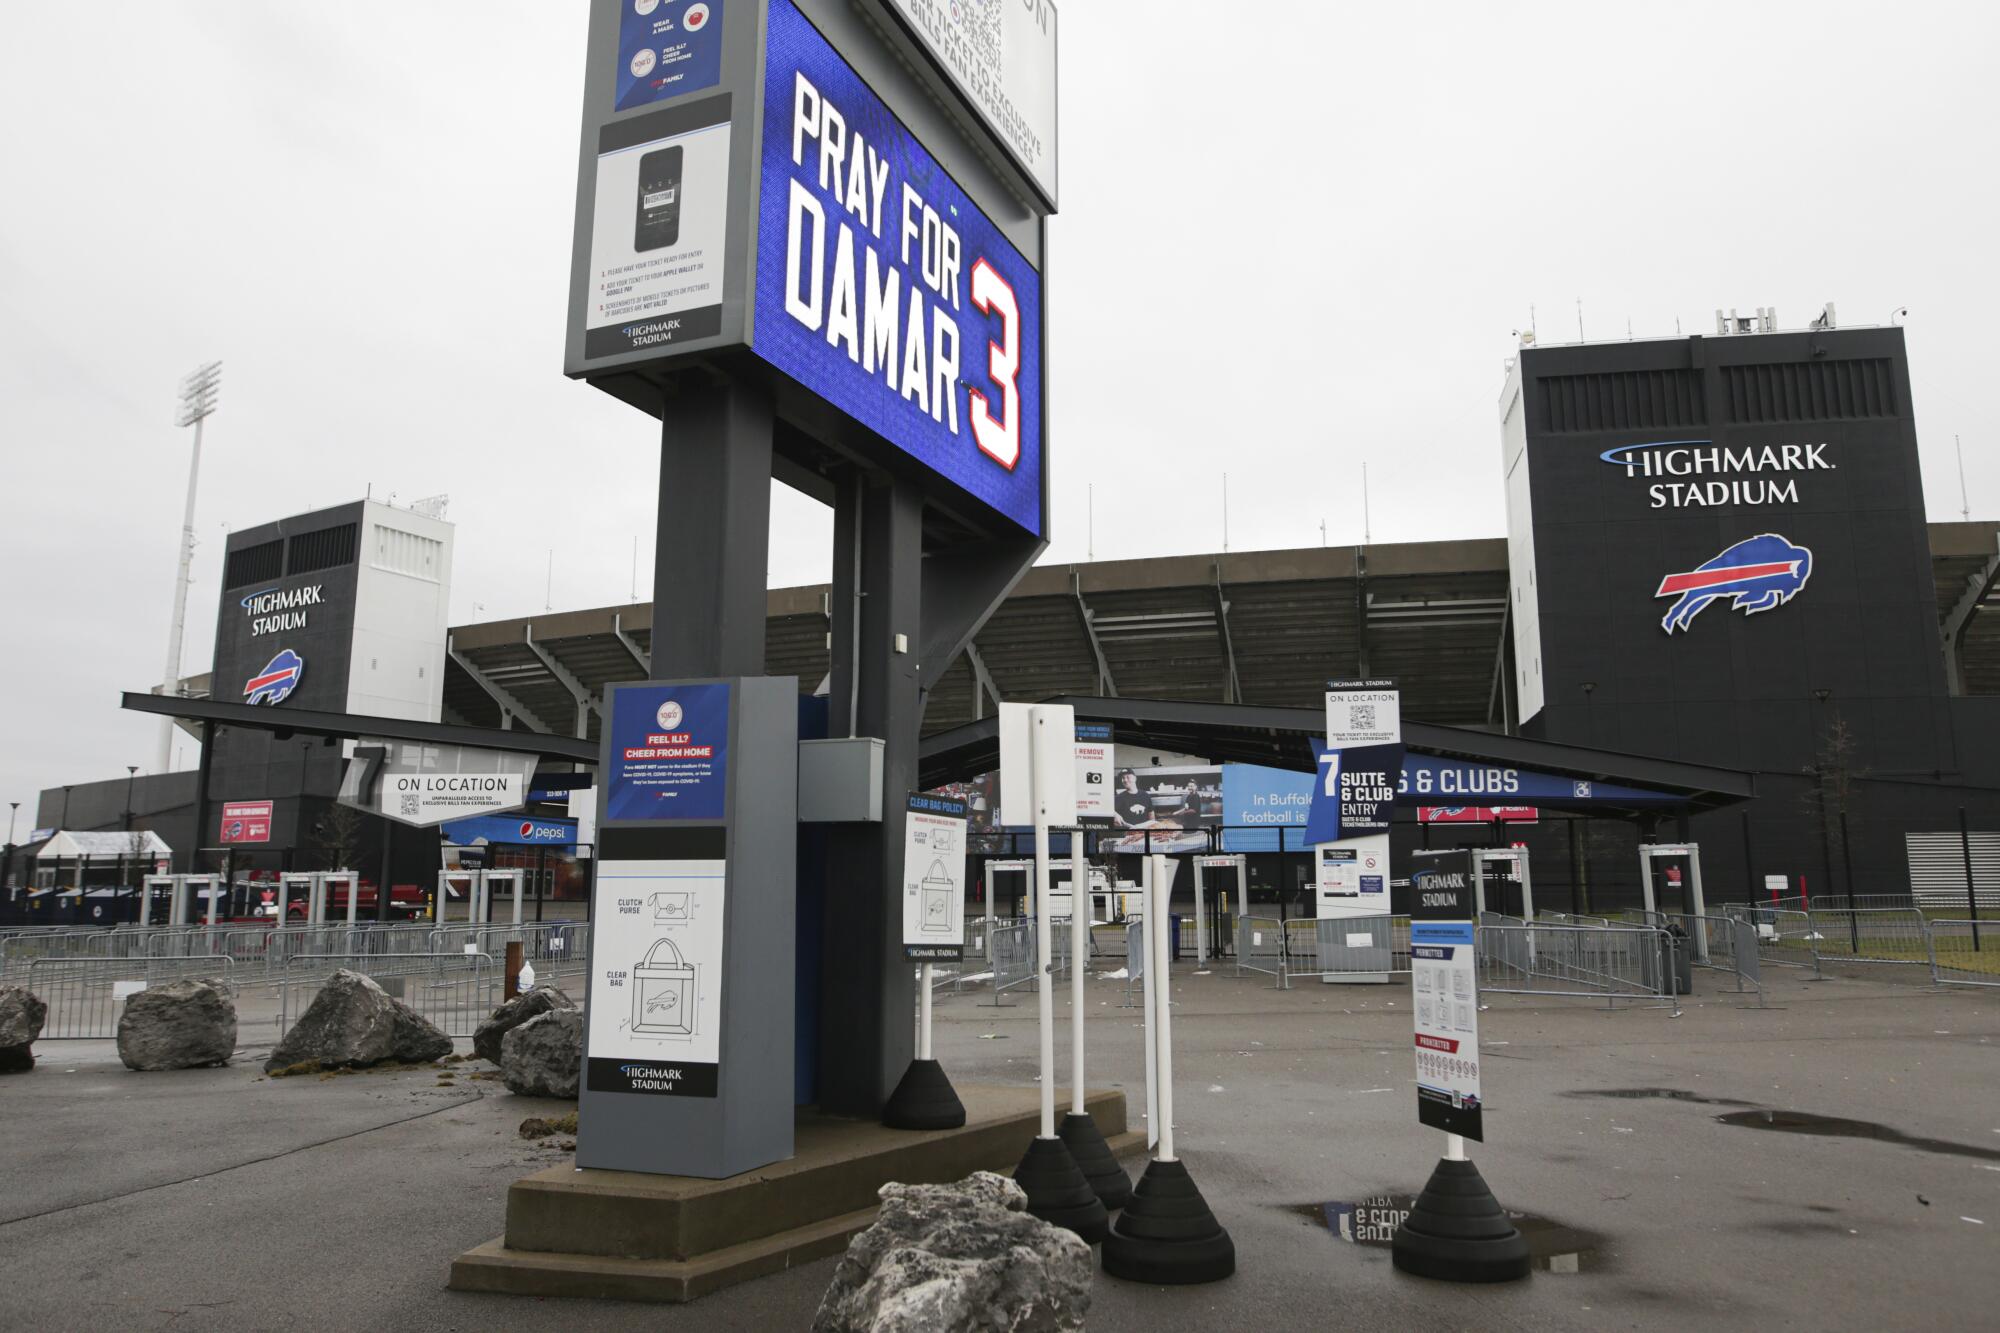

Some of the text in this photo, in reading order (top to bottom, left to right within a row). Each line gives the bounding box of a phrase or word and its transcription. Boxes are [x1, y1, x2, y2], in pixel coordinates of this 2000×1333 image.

[653, 19, 670, 28] WEAR
[658, 24, 674, 33] MASK
[677, 53, 692, 61] HOME
[910, 1, 1034, 165] BILLS FAN EXPERIENCES
[938, 12, 1042, 157] TICKET TO EXCLUSIVE
[793, 70, 960, 311] PRAY FOR
[608, 267, 623, 276] PLEASE
[624, 264, 634, 273] HAVE
[635, 262, 646, 270] YOUR
[648, 259, 663, 268] TICKET
[664, 255, 678, 264] READY
[678, 253, 687, 261] FOR
[688, 250, 703, 259] ENTRY
[616, 278, 627, 287] YOUR
[629, 276, 644, 285] TICKET
[651, 272, 662, 280] YOUR
[663, 268, 677, 277] APPLE
[678, 265, 696, 273] WALLET
[605, 298, 635, 310] SCREENSHOTS
[643, 294, 659, 302] MOBILE
[661, 290, 679, 299] TICKETS
[687, 282, 710, 293] PICTURES
[643, 302, 652, 310] NOT
[653, 299, 667, 308] VALID
[626, 319, 681, 337] HIGHMARK
[785, 177, 1020, 471] DAMAR 3
[633, 331, 672, 347] STADIUM
[1614, 441, 1834, 478] HIGHMARK
[1649, 480, 1799, 508] STADIUM
[244, 584, 325, 617] HIGHMARK
[252, 611, 307, 637] STADIUM
[649, 735, 689, 744] FEEL ILL?
[626, 748, 710, 758] CHEER FROM HOME
[353, 747, 387, 805] 7
[1319, 754, 1339, 797] 7
[1341, 772, 1386, 786] SUITE
[1416, 770, 1433, 793] &
[1440, 769, 1519, 793] CLUBS
[398, 778, 508, 791] ON LOCATION
[1254, 794, 1265, 806] In
[1341, 787, 1394, 801] & CLUB
[910, 797, 963, 814] CLEAR BAG POLICY
[1342, 803, 1378, 815] ENTRY
[1242, 811, 1306, 823] football is
[535, 827, 565, 840] pepsi
[1416, 872, 1464, 890] HIGHMARK
[618, 898, 643, 906] CLUTCH
[1422, 893, 1457, 907] STADIUM
[1416, 948, 1444, 957] PERMITTED
[610, 979, 623, 987] BAG
[624, 1066, 682, 1080] HIGHMARK
[632, 1080, 672, 1090] STADIUM
